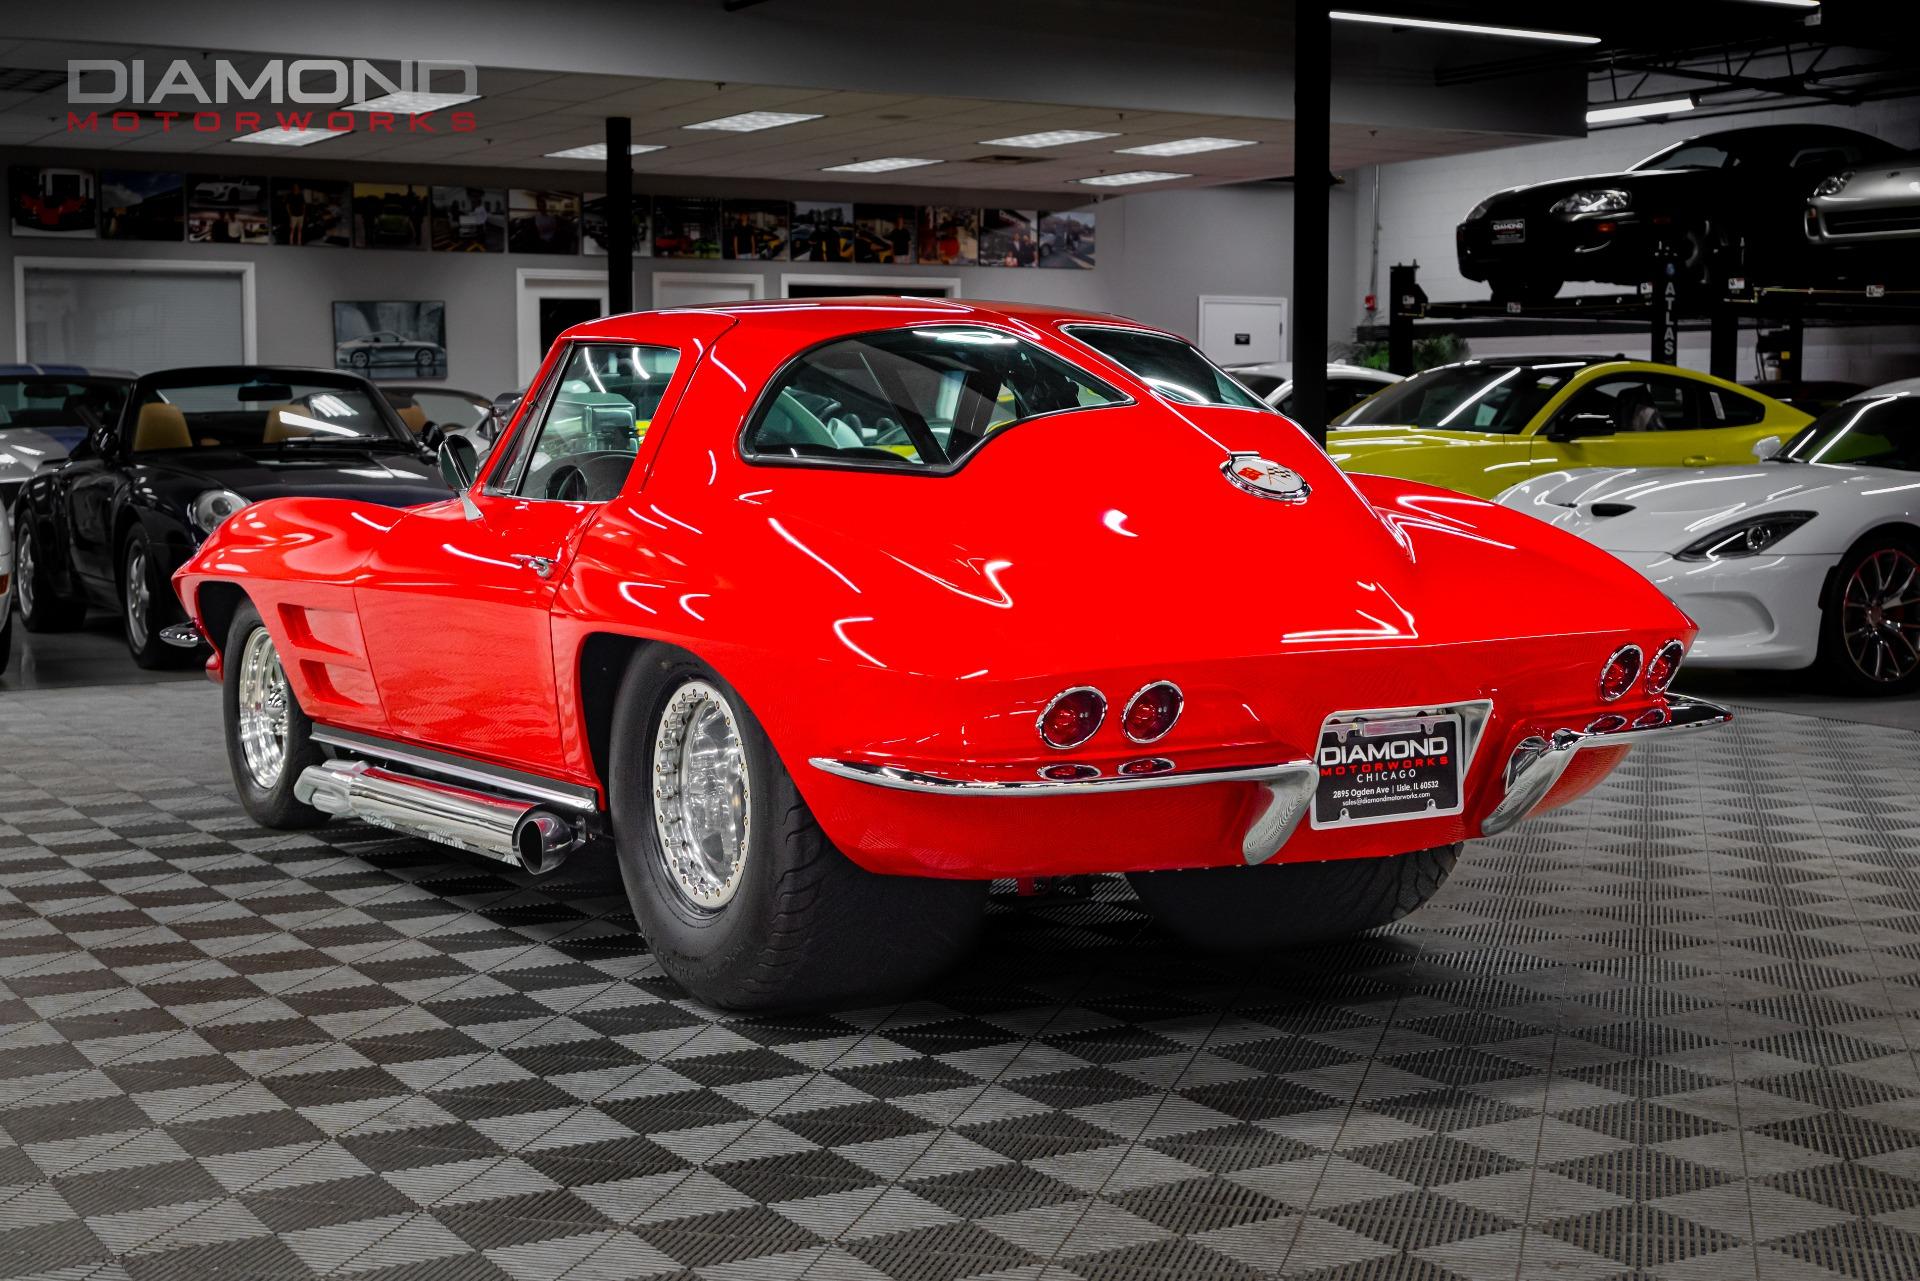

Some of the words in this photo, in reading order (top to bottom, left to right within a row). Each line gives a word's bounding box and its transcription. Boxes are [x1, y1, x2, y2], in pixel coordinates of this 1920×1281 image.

[1664, 282, 1675, 355] ATLAS
[1320, 736, 1448, 766] DIAMOND
[1320, 756, 1449, 777] MOTORWORKS
[1356, 768, 1416, 783] CHICAGO
[1333, 790, 1350, 799] 2895
[1350, 788, 1375, 797] Ogden
[1376, 786, 1390, 794] Ave
[1413, 782, 1419, 790] IL
[1420, 780, 1439, 789] 60532
